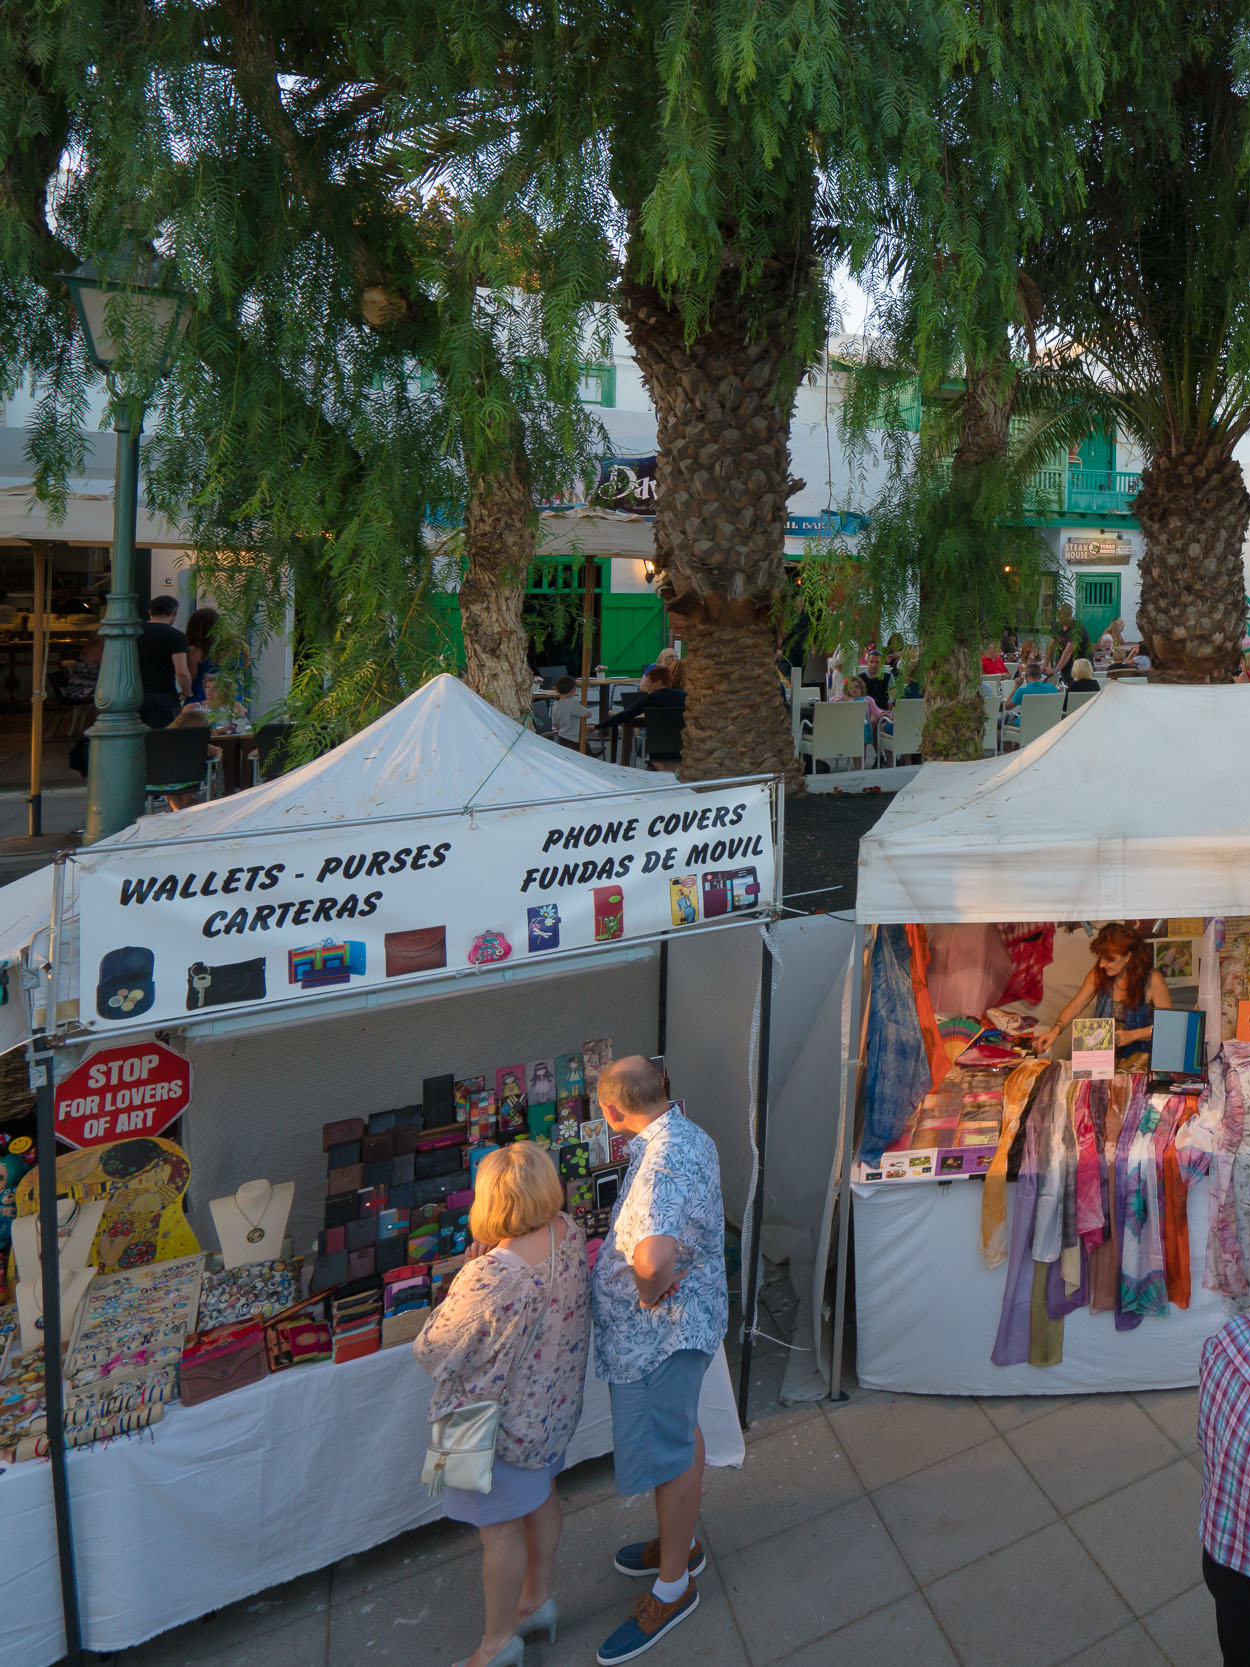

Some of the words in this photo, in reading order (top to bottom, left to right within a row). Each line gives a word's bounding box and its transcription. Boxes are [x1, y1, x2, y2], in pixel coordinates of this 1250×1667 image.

[783, 521, 799, 529] IL
[1065, 543, 1088, 551] STEAK
[1065, 551, 1088, 559] HOUSE
[542, 818, 639, 852] PHONE
[647, 803, 746, 837] COVERS
[119, 863, 286, 906] WALLETS
[316, 842, 452, 883] PURSES
[520, 854, 634, 892] FUNDAS
[641, 847, 678, 874] DE
[685, 835, 763, 867] MOVIL
[202, 891, 383, 938] CARTERAS
[321, 937, 333, 947] 20
[88, 1054, 159, 1088] STOP
[58, 1096, 99, 1120] FOR
[105, 1080, 183, 1111] LOVERS
[84, 1116, 110, 1139] OF
[115, 1108, 156, 1133] ART
